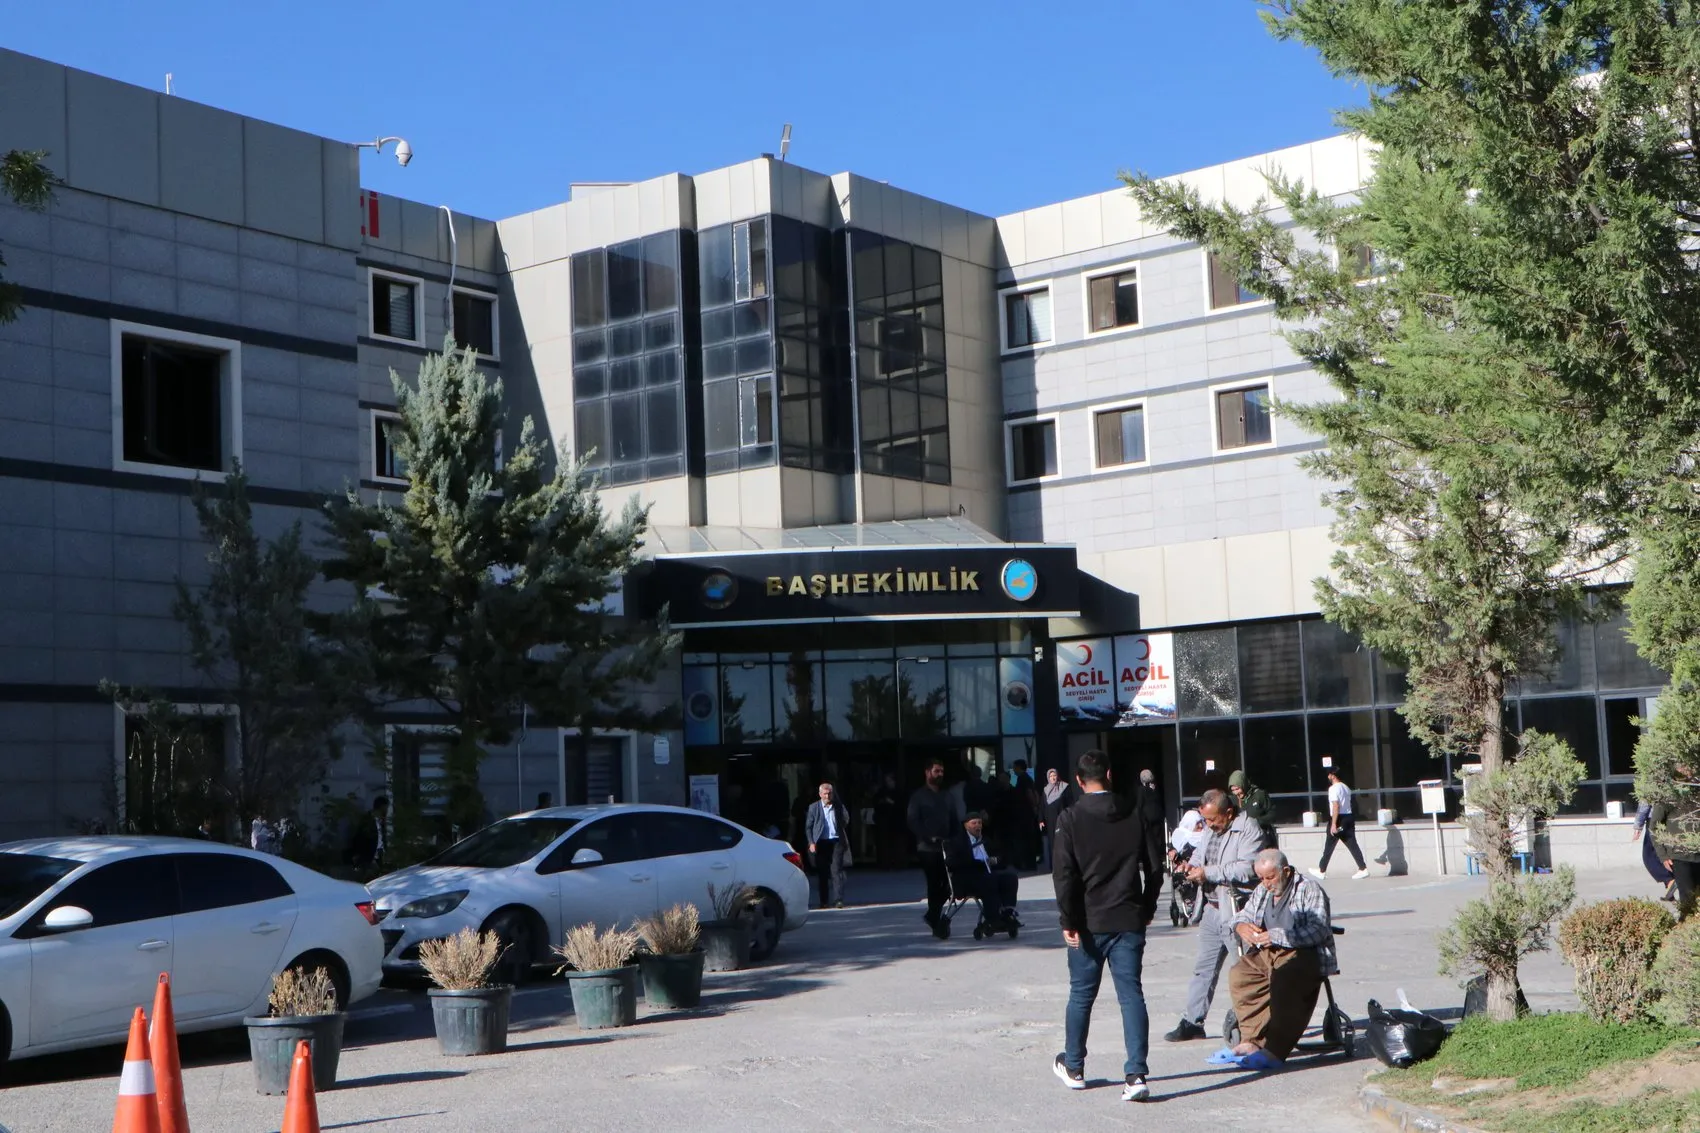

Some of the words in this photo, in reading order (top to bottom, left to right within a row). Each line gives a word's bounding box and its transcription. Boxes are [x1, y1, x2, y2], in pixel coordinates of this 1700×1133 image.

[766, 566, 980, 599] BAŞHEKİMLİK
[1061, 667, 1110, 688] ACİL
[1119, 662, 1170, 683] ACİL
